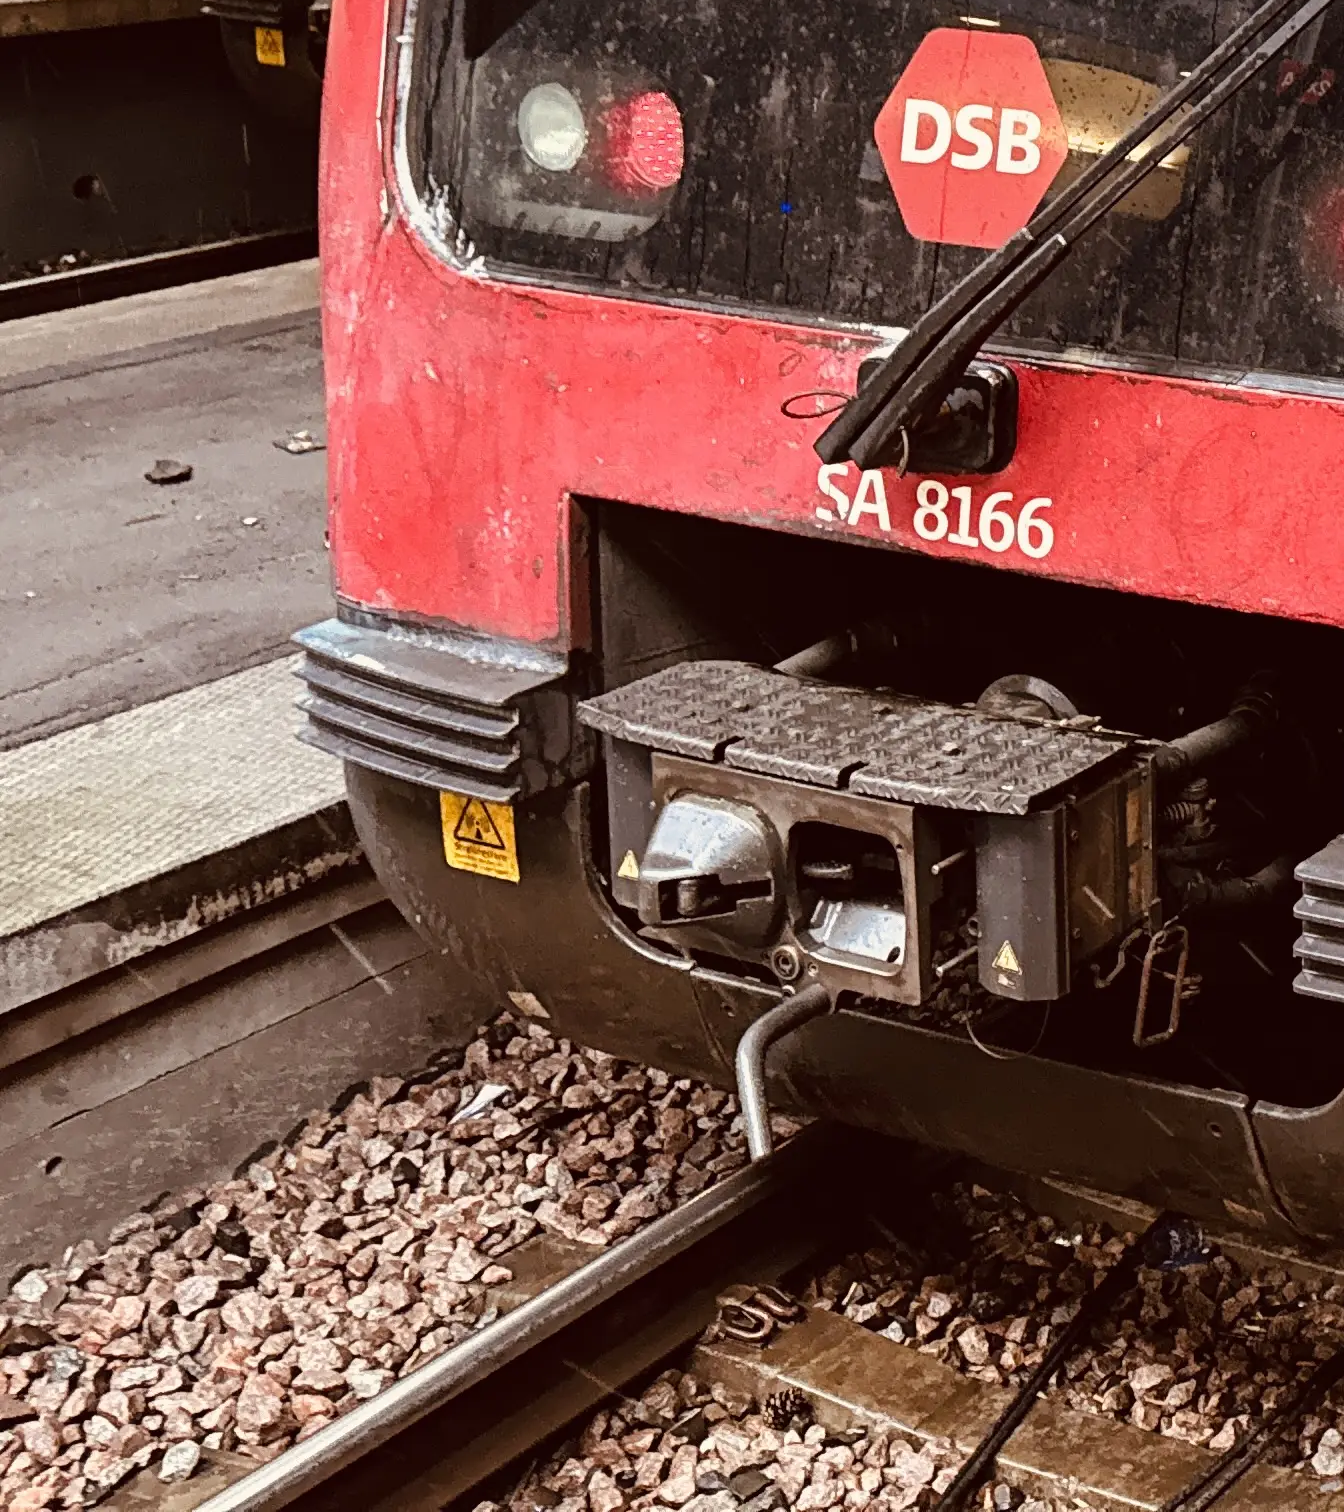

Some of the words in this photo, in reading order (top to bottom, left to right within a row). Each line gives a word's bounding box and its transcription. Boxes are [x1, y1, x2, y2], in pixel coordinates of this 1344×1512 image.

[900, 98, 1041, 175] DSB
[815, 463, 891, 531] SA
[913, 480, 1054, 558] 8166
